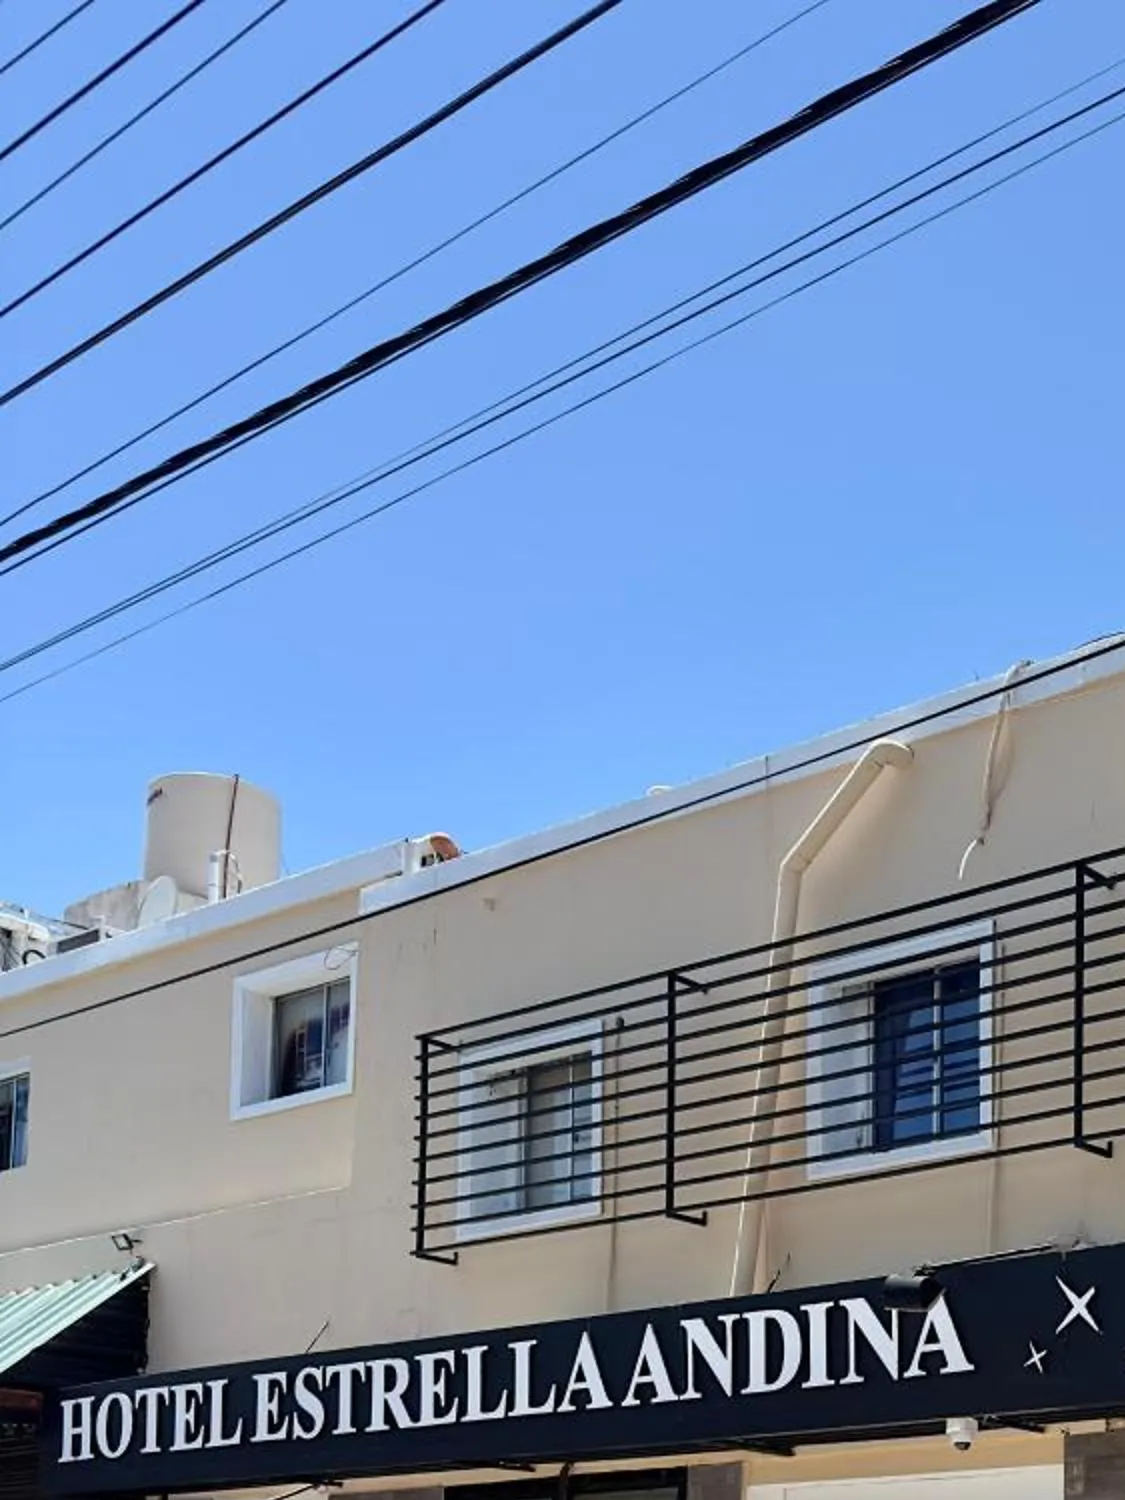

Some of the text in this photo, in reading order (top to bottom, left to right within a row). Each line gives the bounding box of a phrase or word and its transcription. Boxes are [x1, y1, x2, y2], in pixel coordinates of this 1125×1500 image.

[58, 1294, 976, 1464] HOTEL ESTRELLA ANDINA
